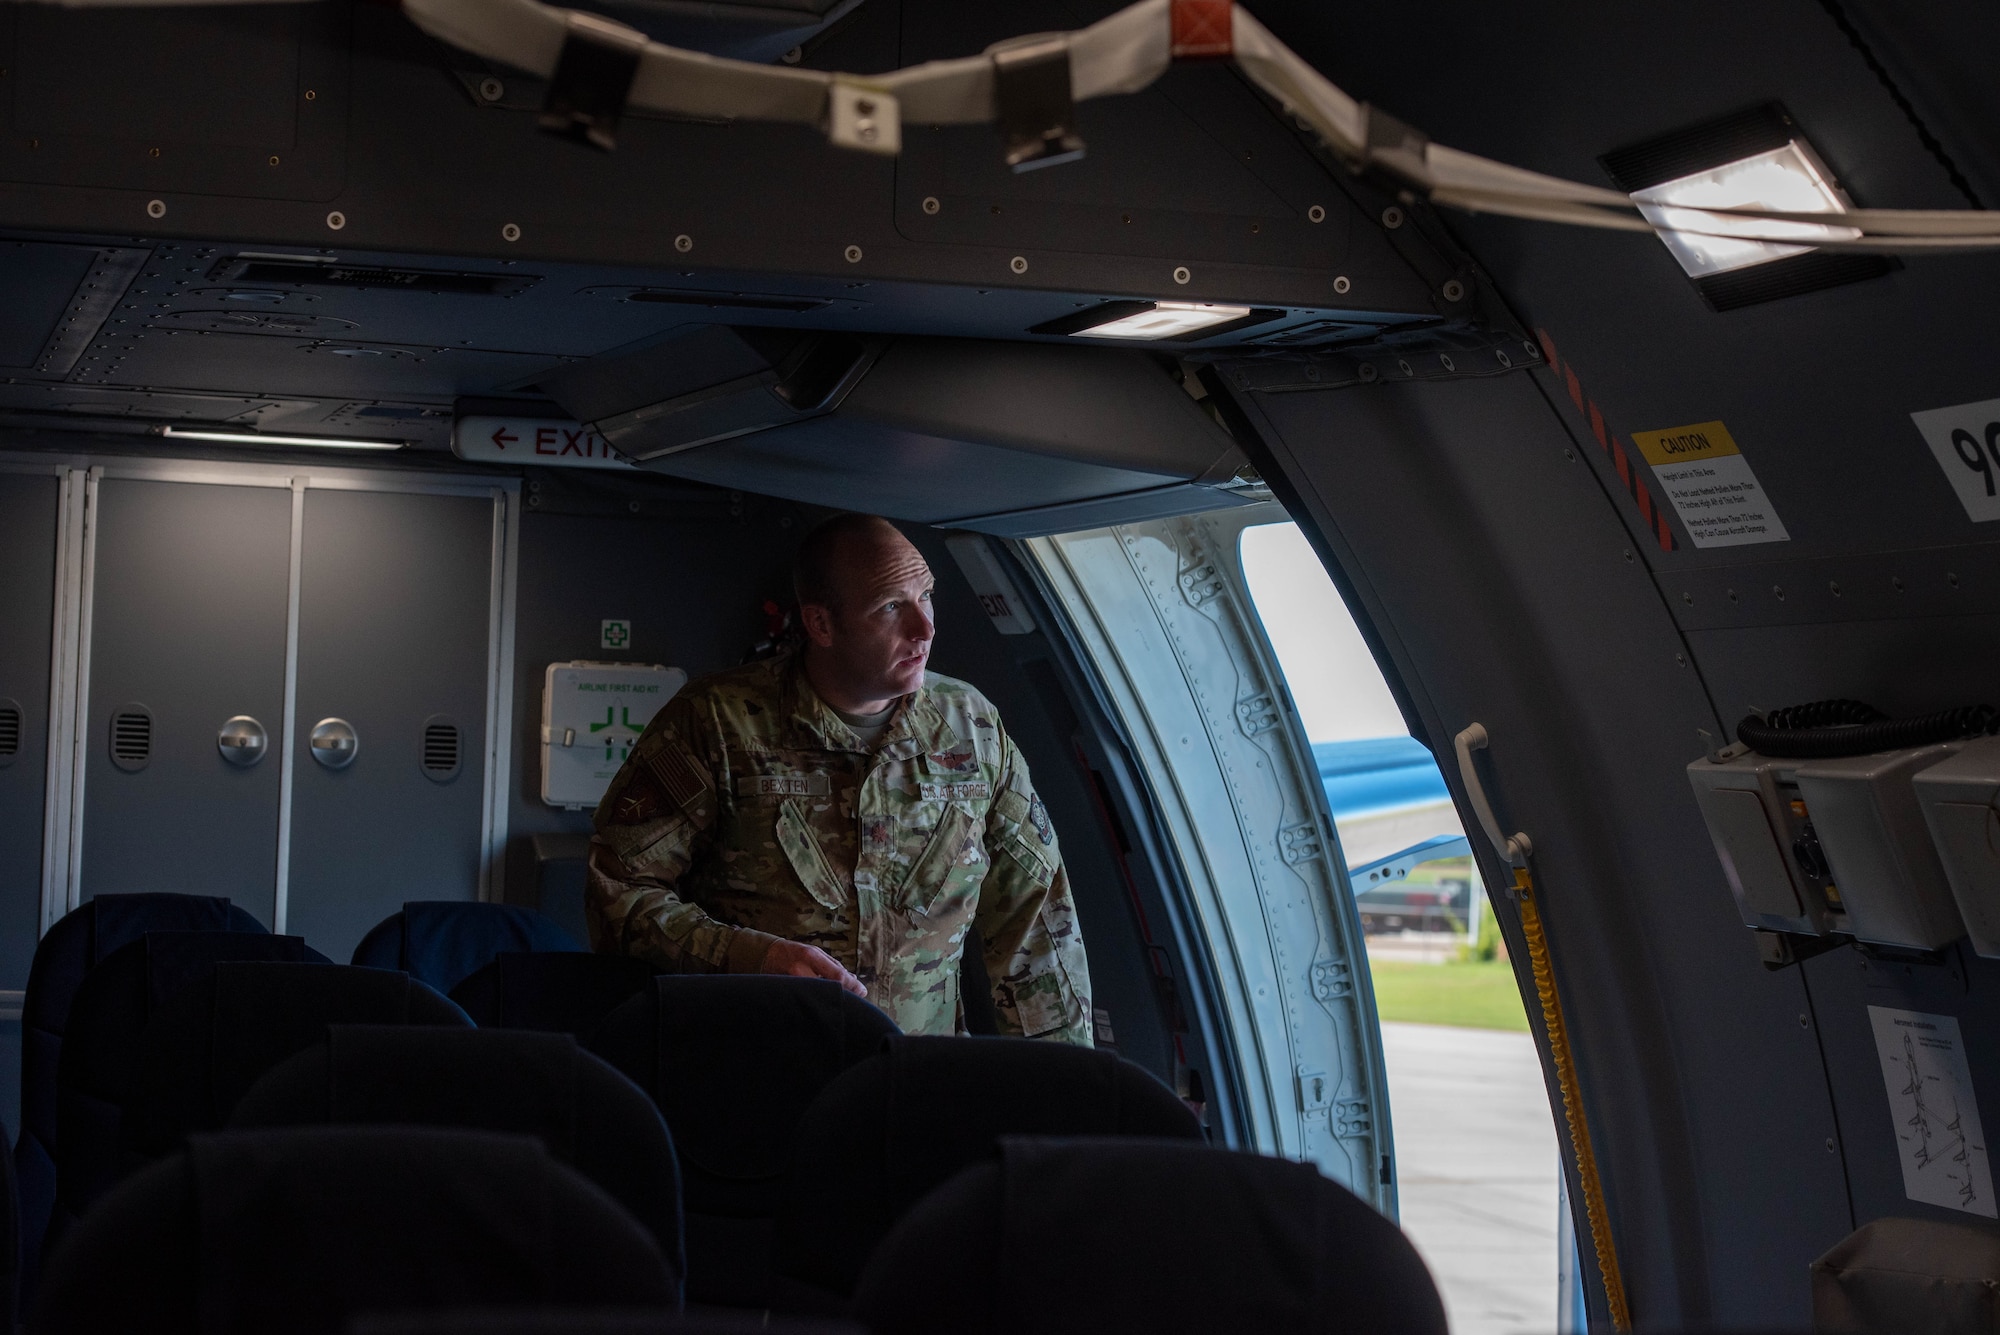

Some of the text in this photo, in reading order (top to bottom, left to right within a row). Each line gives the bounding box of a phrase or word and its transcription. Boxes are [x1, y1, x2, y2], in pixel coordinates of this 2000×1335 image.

[1660, 433, 1711, 454] CAUTION
[1662, 472, 1678, 482] Height
[1678, 471, 1689, 479] Limit
[1692, 469, 1704, 477] This
[1703, 468, 1716, 476] Area
[1671, 482, 1755, 498] Do Not Load Netted Pallets More Than
[1677, 501, 1686, 509] 72
[1699, 499, 1711, 509] High
[1723, 496, 1734, 504] This
[1687, 518, 1704, 527] Netted
[1702, 517, 1719, 526] Pallets
[1716, 516, 1730, 524] More
[1728, 515, 1741, 523] Than
[1740, 513, 1749, 521] 72
[1693, 529, 1705, 540] High
[1704, 529, 1715, 537] Can
[1714, 528, 1730, 536] Cause
[1729, 525, 1746, 534] Aircraft
[979, 594, 1013, 617] EXIT
[578, 683, 660, 694] AIRLINE FIRST AID KIT
[761, 778, 809, 793] BEXTEN
[922, 783, 986, 799] U.S. AIR FORCE
